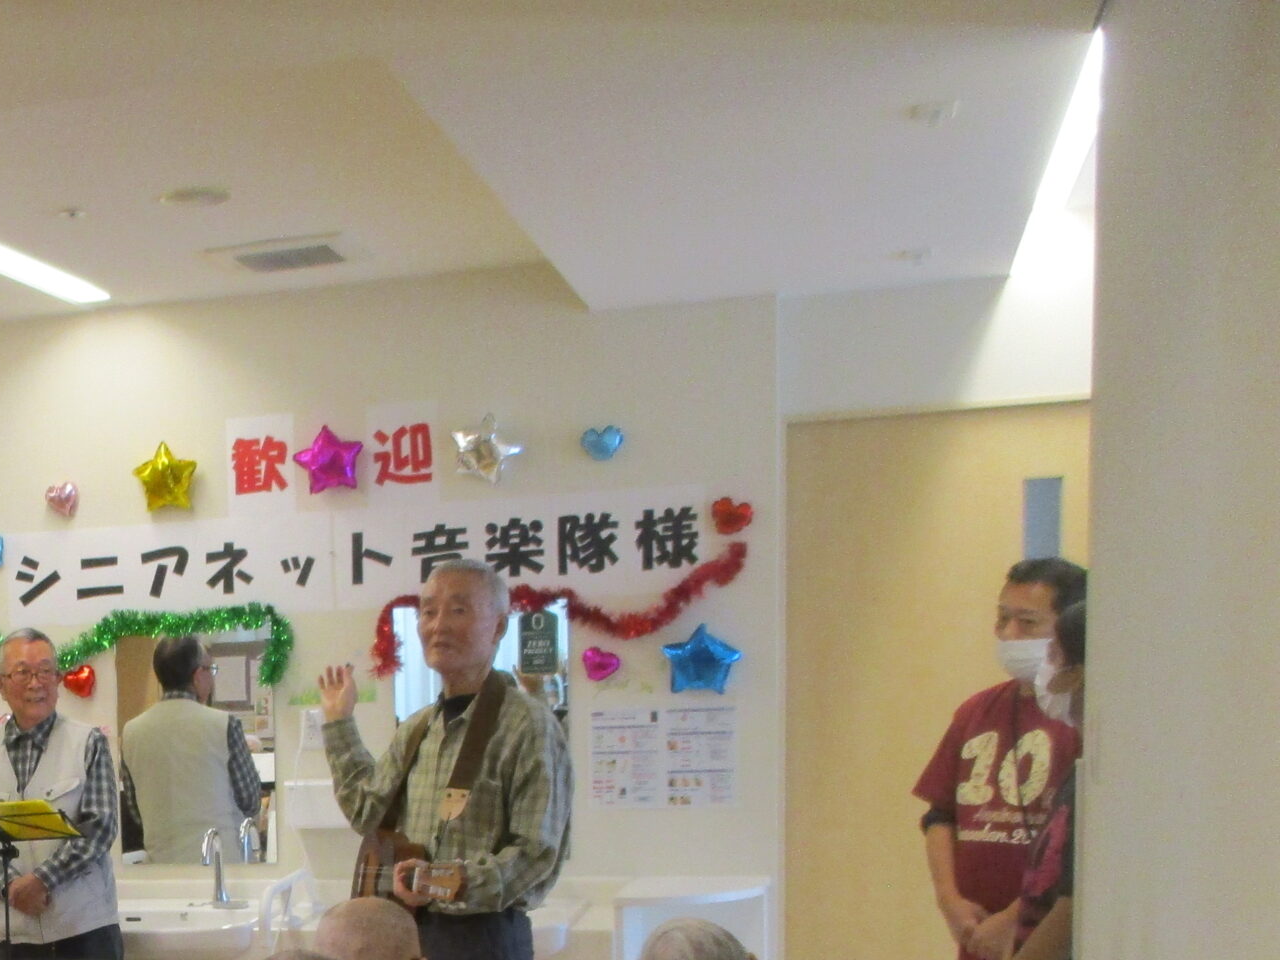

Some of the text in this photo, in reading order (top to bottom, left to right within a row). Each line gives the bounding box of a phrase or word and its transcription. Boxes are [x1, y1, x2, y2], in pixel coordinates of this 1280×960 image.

[15, 506, 698, 607] シニアネット音楽隊様
[956, 728, 1051, 807] 10
